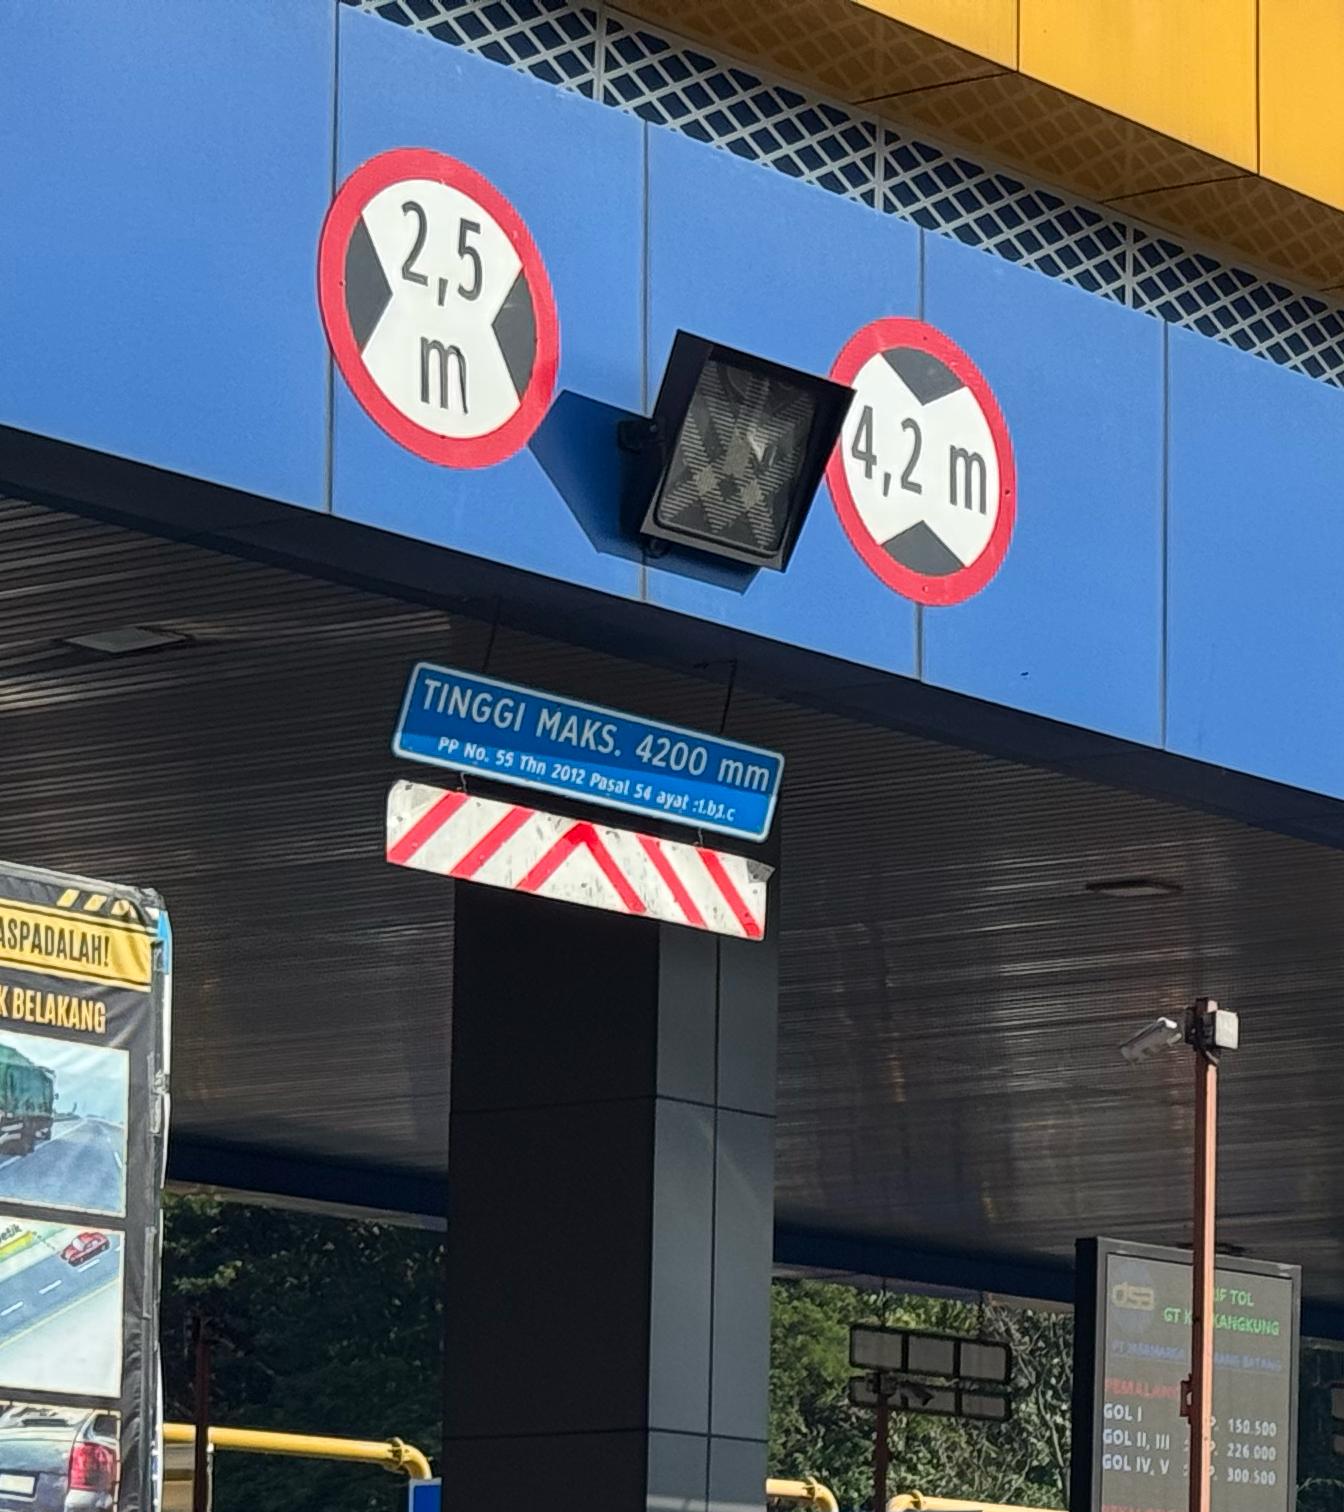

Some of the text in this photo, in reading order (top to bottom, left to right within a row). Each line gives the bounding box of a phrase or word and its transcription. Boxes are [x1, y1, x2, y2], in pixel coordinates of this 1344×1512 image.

[400, 200, 484, 306] 2,5
[420, 335, 468, 414] m
[851, 406, 987, 514] 4,2 m
[423, 678, 770, 792] TINGGI MAKS. 4200 mm
[438, 736, 459, 753] PP
[464, 743, 490, 763] No.
[519, 752, 546, 776] Thn
[551, 763, 584, 786] 2012
[589, 772, 629, 797] Pasal
[656, 788, 690, 815] ayat
[12, 989, 107, 1034] BELAKANG
[1163, 1307, 1180, 1323] GT
[1230, 1290, 1254, 1306] TOL
[1103, 1403, 1133, 1421] GOL
[1102, 1429, 1132, 1446] GOL
[1102, 1454, 1132, 1471] GOL
